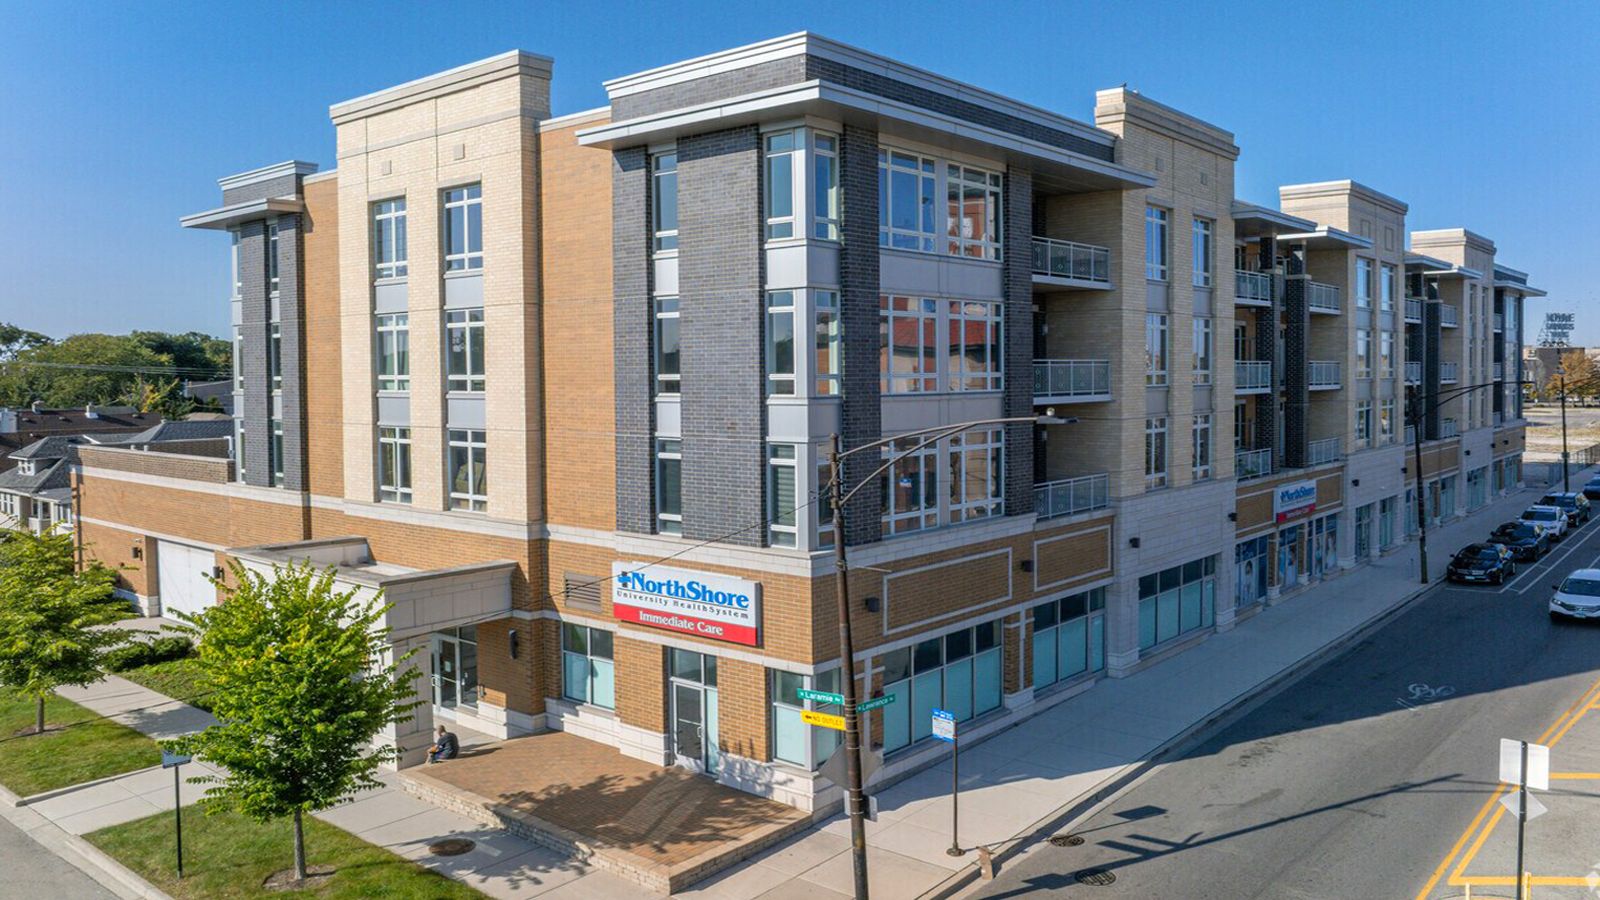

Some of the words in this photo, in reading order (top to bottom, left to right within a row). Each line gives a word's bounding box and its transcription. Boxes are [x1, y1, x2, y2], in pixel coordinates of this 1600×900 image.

[632, 571, 749, 609] NorthShore
[617, 590, 668, 606] University
[673, 597, 749, 619] HealthSystem
[639, 610, 695, 630] Immediate
[697, 621, 723, 635] Care
[804, 692, 834, 702] Laramie
[812, 715, 820, 723] NO
[822, 716, 842, 726] OUTLET
